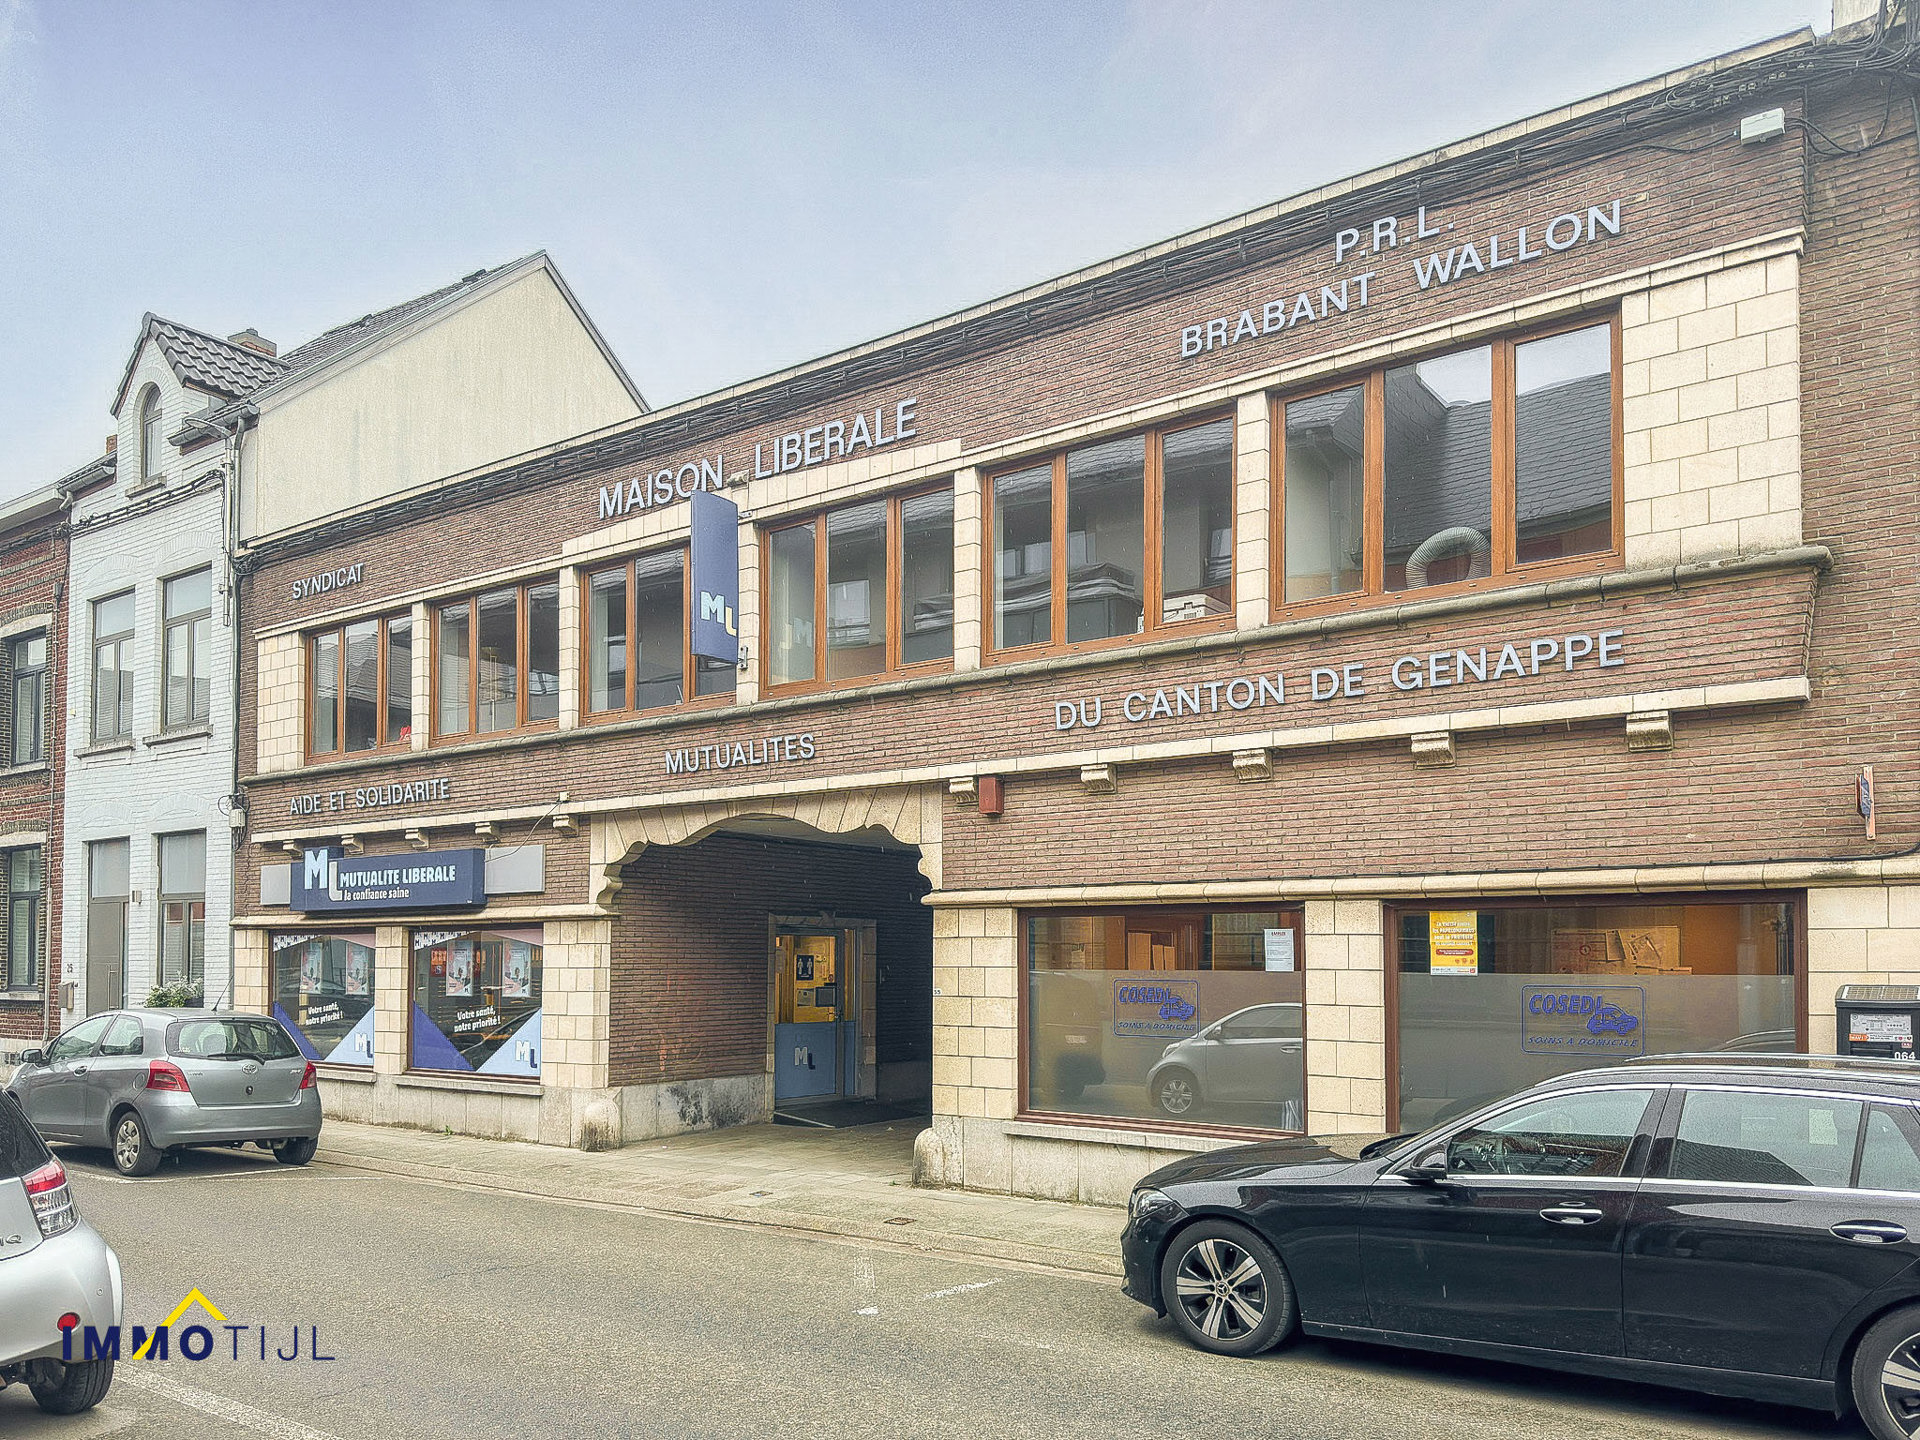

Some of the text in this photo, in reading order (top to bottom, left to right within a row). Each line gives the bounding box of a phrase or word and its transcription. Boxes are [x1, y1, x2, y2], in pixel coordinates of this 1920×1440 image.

[1334, 206, 1454, 263] P.R.L.
[1180, 200, 1621, 358] BRABANT WALLON
[599, 399, 917, 519] MAISON LIBERALE
[292, 563, 364, 599] SYNDICAT
[700, 591, 737, 637] ML
[1054, 629, 1625, 730] DU CANTON DE GENAPPE
[665, 733, 815, 774] MUTUALITES
[289, 778, 450, 815] AIDE ET SOLIDARITE
[340, 869, 399, 888] MUTUALITE
[402, 865, 456, 884] LIBERALE
[344, 886, 409, 901] la confiance saine
[457, 1010, 475, 1021] Votre
[1529, 994, 1603, 1014] COSEDI
[454, 1022, 471, 1032] notre
[516, 1040, 538, 1069] ML
[794, 1046, 816, 1070] ML
[1894, 1051, 1916, 1060] 064
